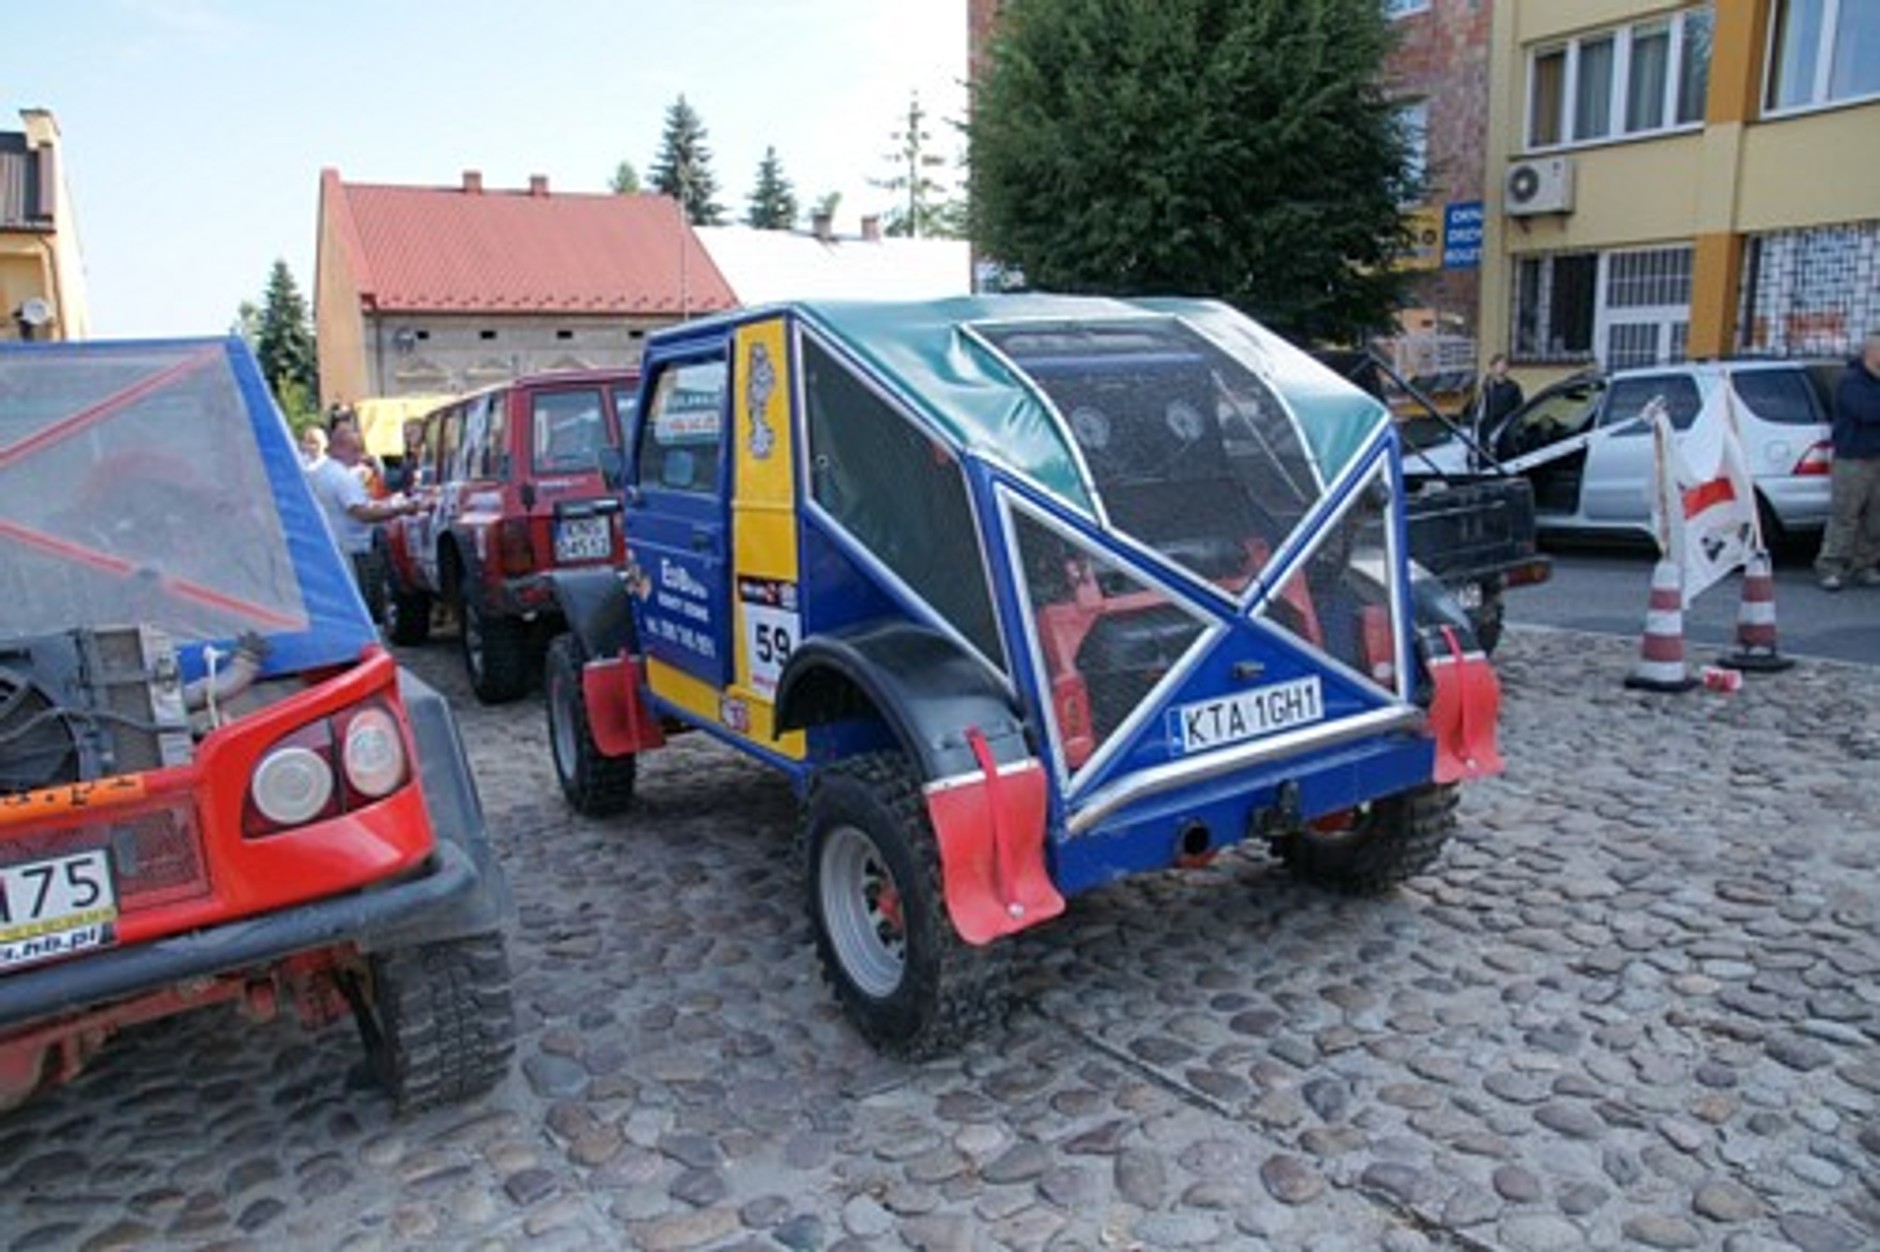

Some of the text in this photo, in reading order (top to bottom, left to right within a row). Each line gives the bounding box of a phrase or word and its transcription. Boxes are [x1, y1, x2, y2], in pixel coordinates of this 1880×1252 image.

[756, 623, 791, 667] 59
[1185, 684, 1317, 745] KTA 1GH1
